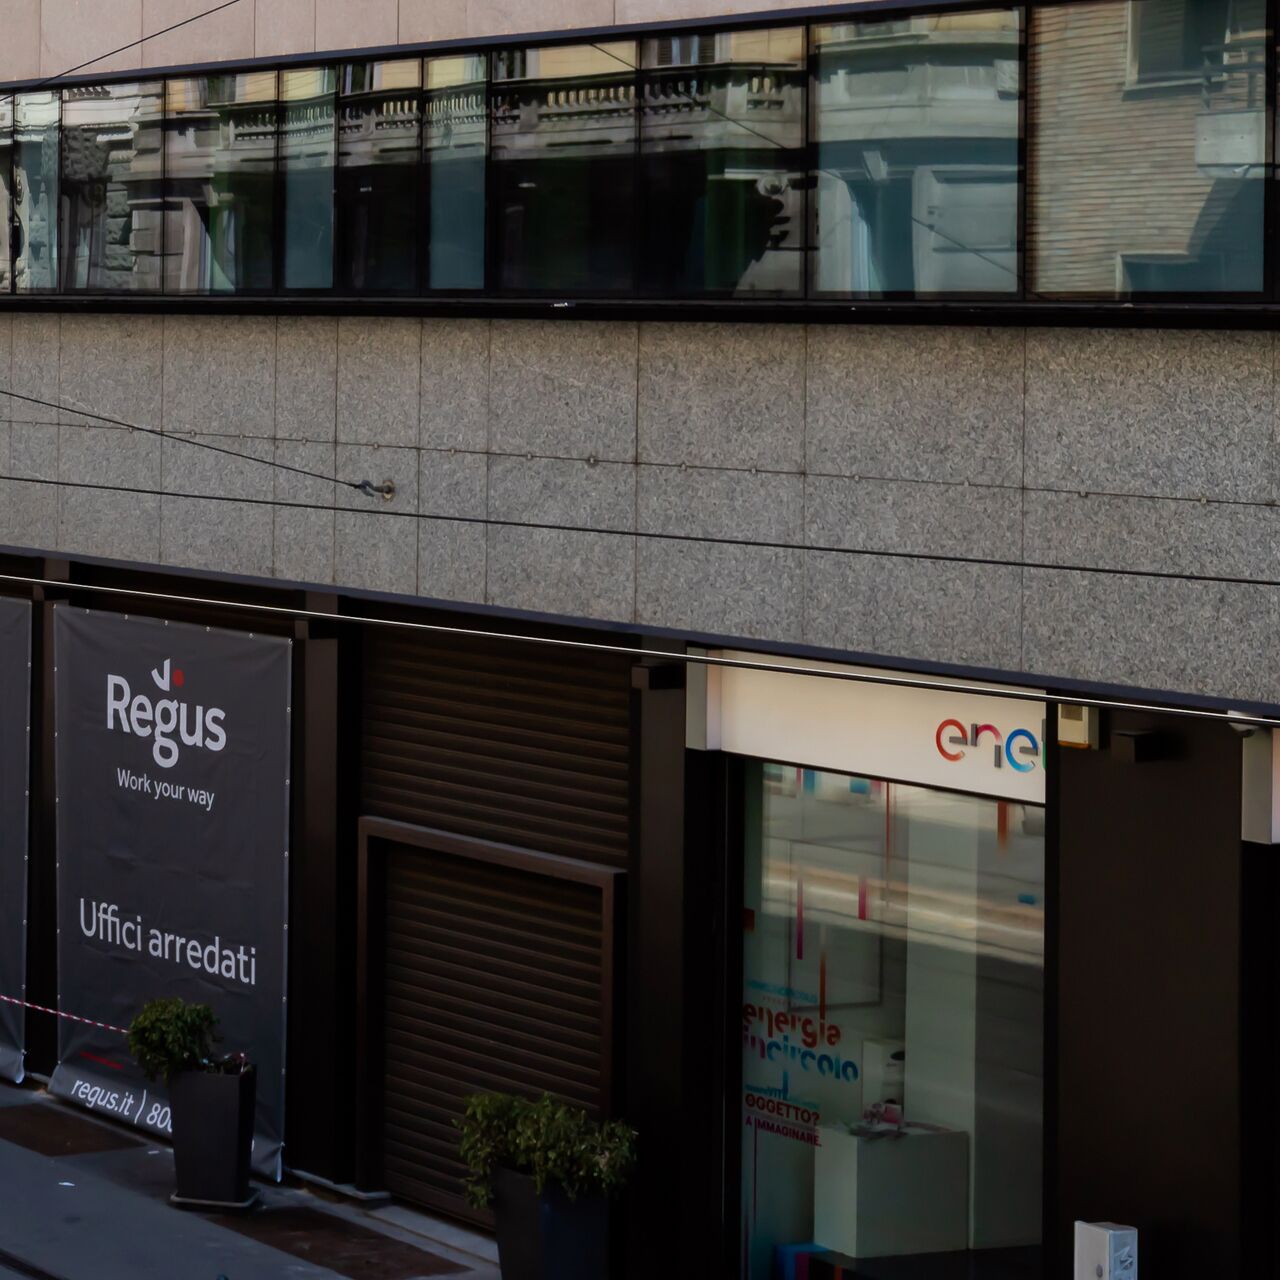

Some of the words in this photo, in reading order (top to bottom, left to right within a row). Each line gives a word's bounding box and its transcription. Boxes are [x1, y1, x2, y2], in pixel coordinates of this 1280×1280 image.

[107, 673, 226, 768] Regus
[117, 767, 151, 793] Work
[153, 780, 185, 800] your
[187, 787, 215, 812] way
[80, 898, 142, 952] Uffici
[148, 935, 256, 986] arredati
[742, 1003, 842, 1049] energia
[71, 1079, 135, 1116] regus.it
[744, 1093, 821, 1127] OGGETTO?
